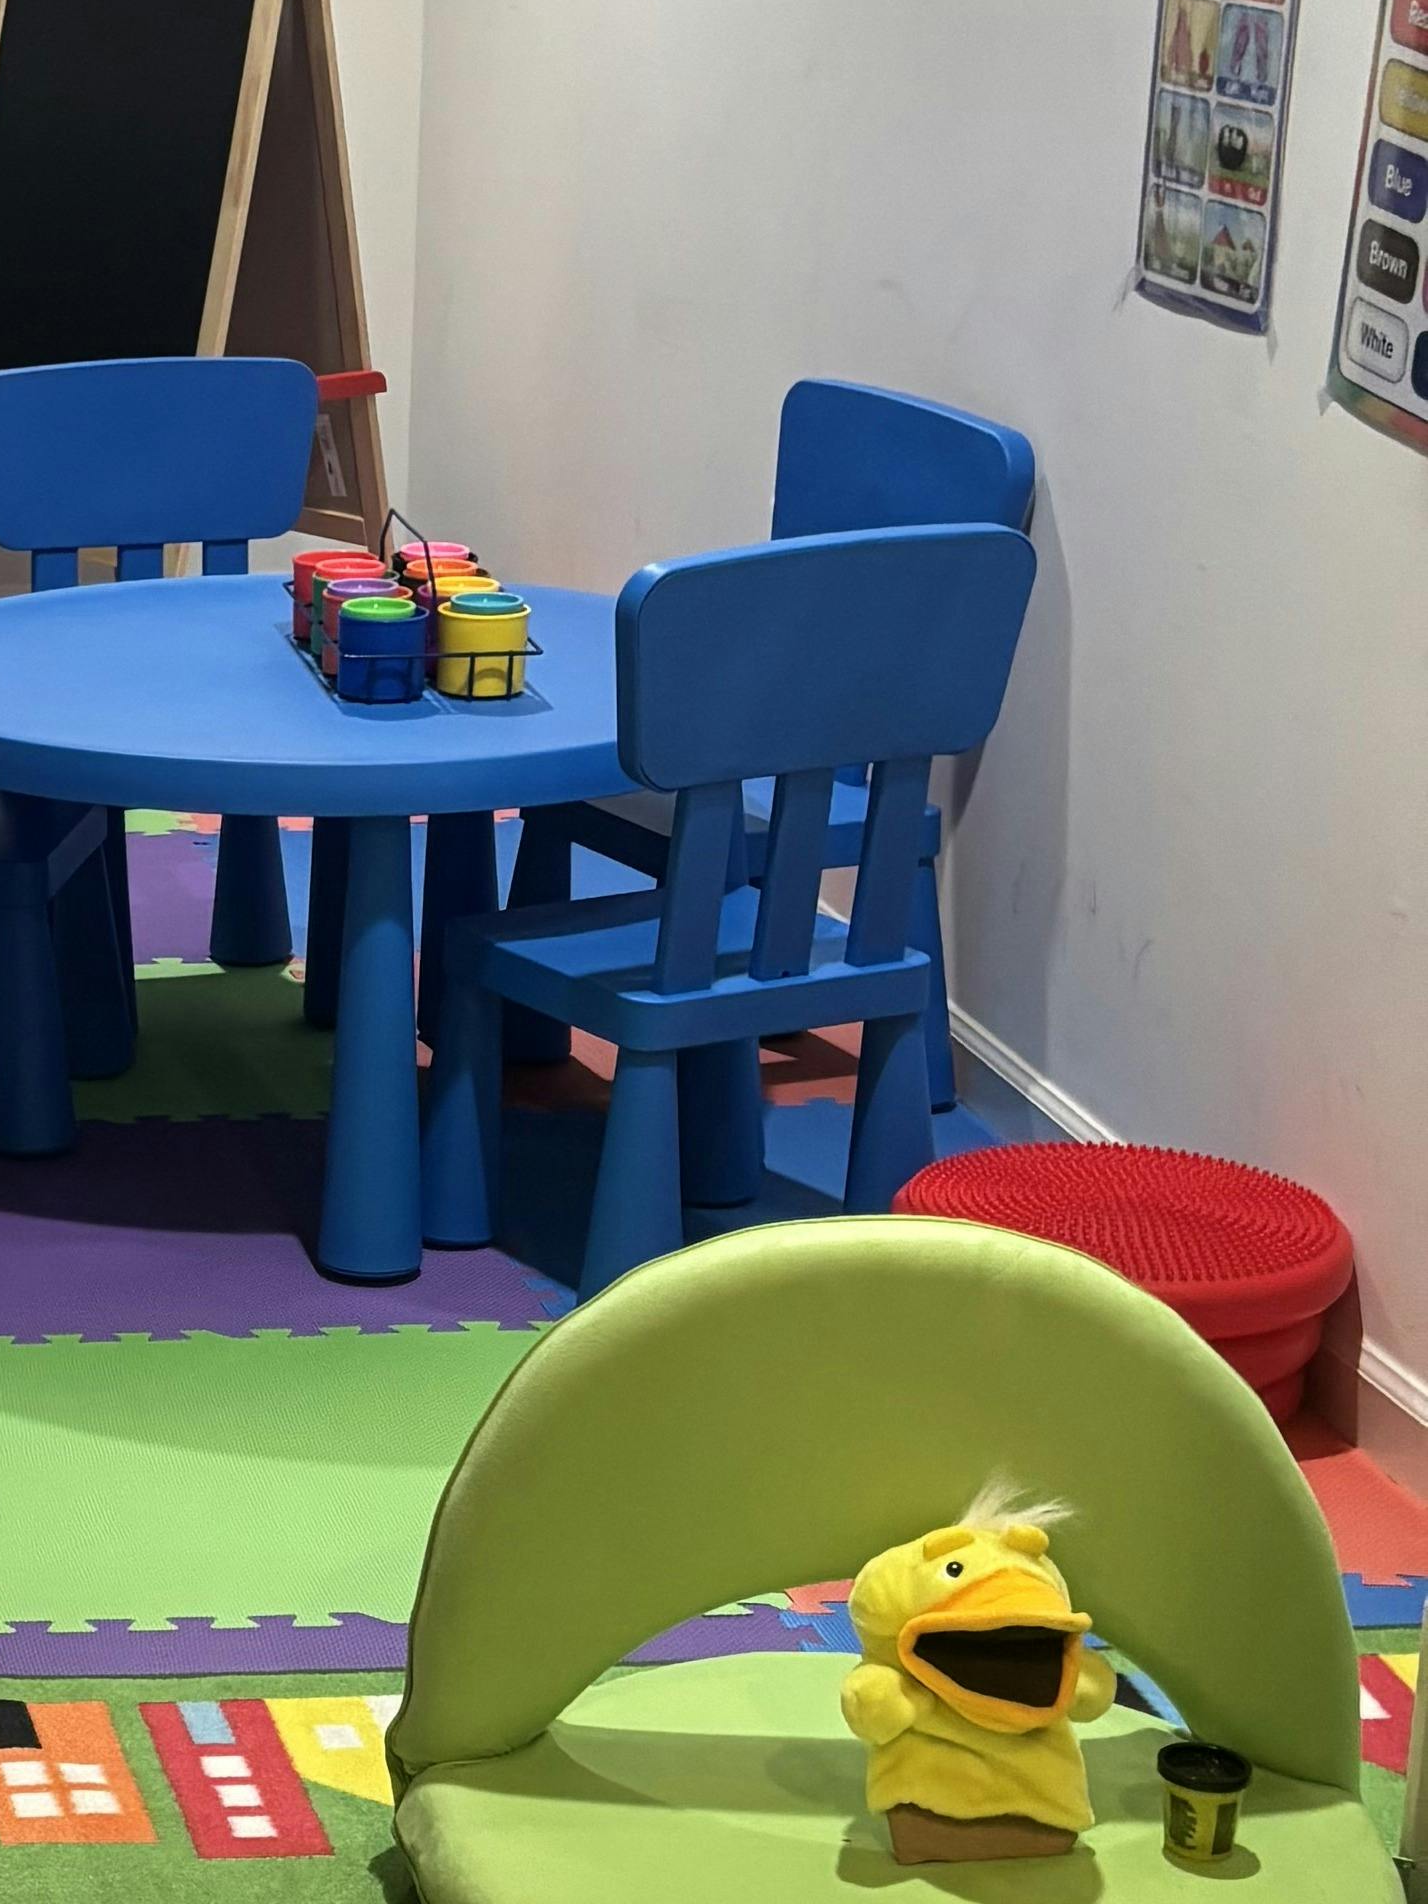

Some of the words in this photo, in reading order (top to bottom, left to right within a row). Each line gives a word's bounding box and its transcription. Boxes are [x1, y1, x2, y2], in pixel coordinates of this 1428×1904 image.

[1385, 164, 1413, 197] Blue
[1369, 240, 1408, 280] Brown
[1361, 322, 1393, 358] White
